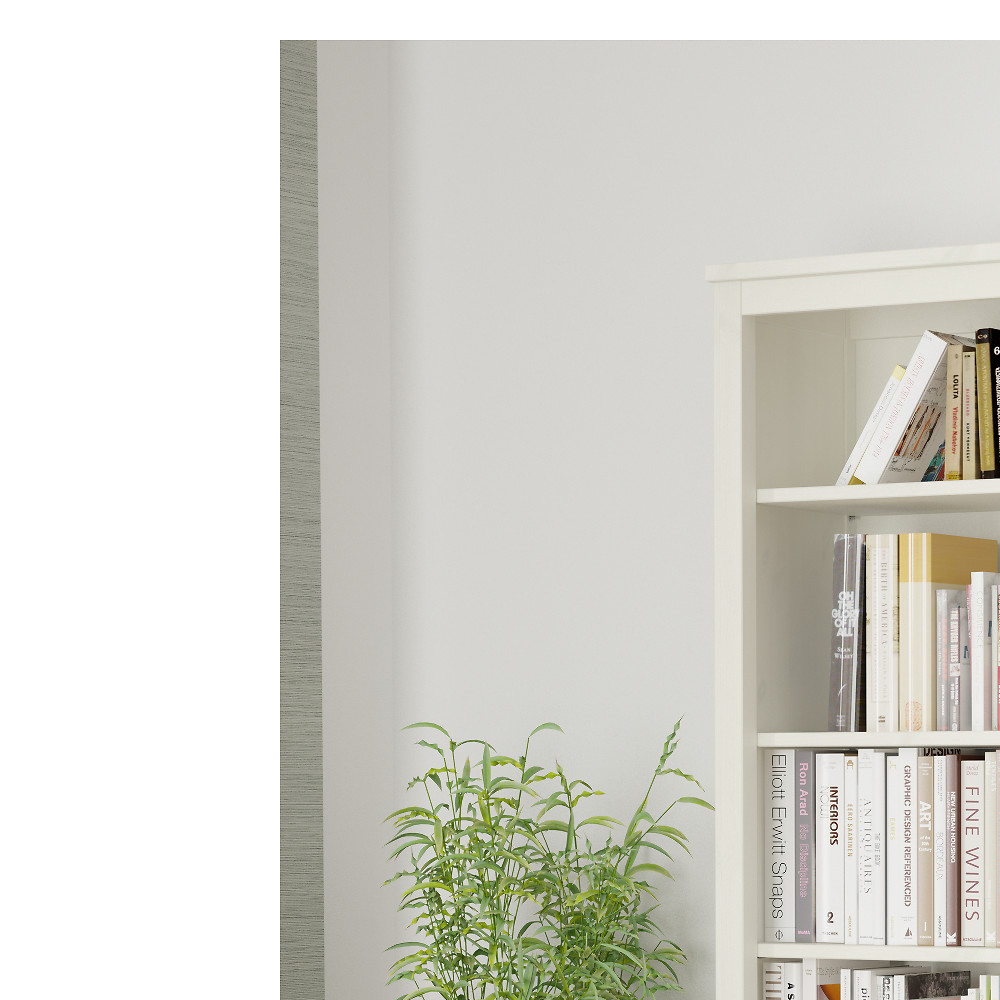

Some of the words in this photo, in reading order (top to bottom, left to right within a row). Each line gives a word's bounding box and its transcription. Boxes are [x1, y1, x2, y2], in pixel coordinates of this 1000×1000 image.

[838, 601, 854, 609] THE
[839, 592, 854, 600] OH
[832, 609, 859, 618] GLORY
[837, 627, 853, 637] ALL
[771, 754, 787, 800] Elliott
[799, 762, 809, 786] Ron
[799, 789, 809, 816] Arad
[829, 786, 839, 846] INTERIORS
[919, 800, 931, 831] ART
[965, 786, 980, 836] FINE
[771, 806, 787, 855] Erwitt
[799, 824, 809, 840] No
[862, 798, 872, 894] ANTIQUAIRES
[797, 843, 809, 898] Discipline
[935, 832, 944, 880] BORDEAUX
[768, 861, 787, 919] Snaps
[965, 846, 980, 921] WINES
[827, 911, 834, 924] 2
[787, 982, 795, 990] A
